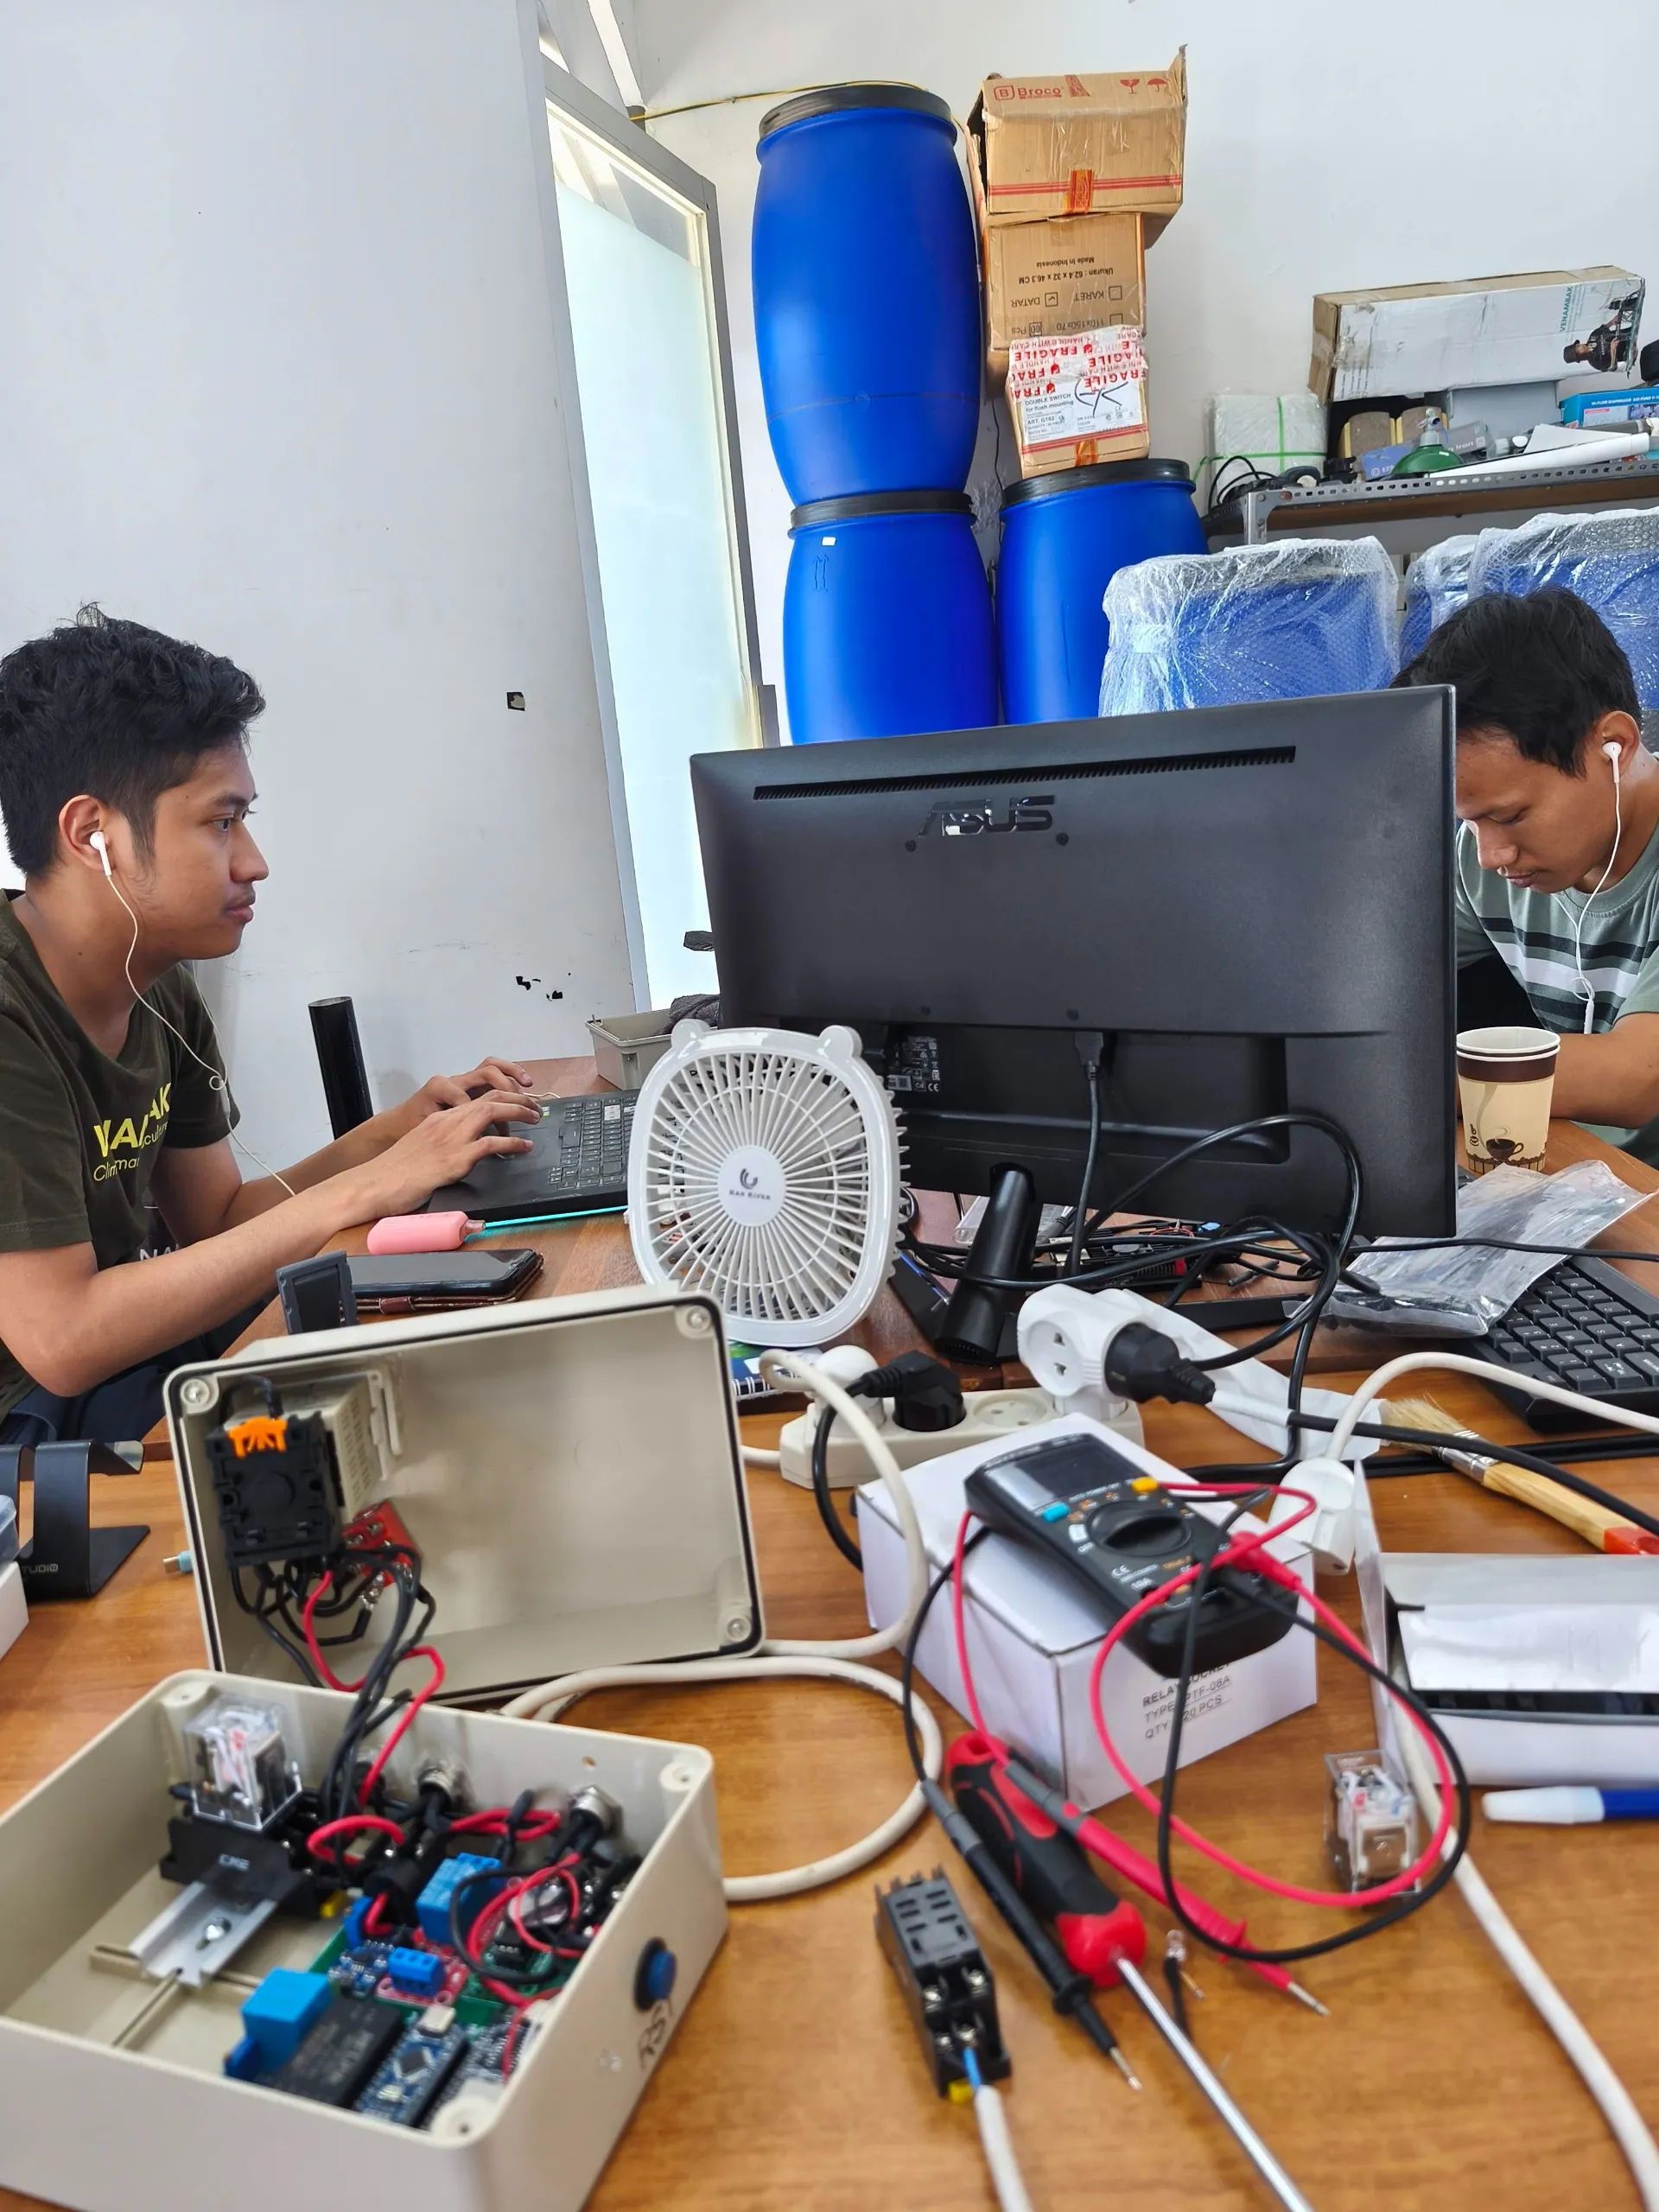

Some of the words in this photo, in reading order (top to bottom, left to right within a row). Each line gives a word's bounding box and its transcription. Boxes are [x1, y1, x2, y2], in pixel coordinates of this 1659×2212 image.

[1017, 87, 1062, 97] Broco
[1036, 259, 1068, 268] Indonesia
[1068, 270, 1084, 279] 62.4
[1011, 296, 1040, 308] DATAR
[1074, 290, 1104, 301] KARET
[1560, 285, 1573, 333] VENAMBAK
[1014, 346, 1077, 362] FRAGILE
[1084, 369, 1147, 388] FRAGILE
[1010, 385, 1041, 400] FRA
[1025, 397, 1048, 406] DOUBLE
[1049, 393, 1071, 402] SWITCH
[1048, 400, 1074, 410] mounting
[918, 795, 1056, 837] ASUS
[22, 1563, 59, 1574] TUDIO
[1187, 1662, 1232, 1685] OCKE
[1183, 1707, 1196, 1721] 20
[1198, 1694, 1223, 1712] PCS
